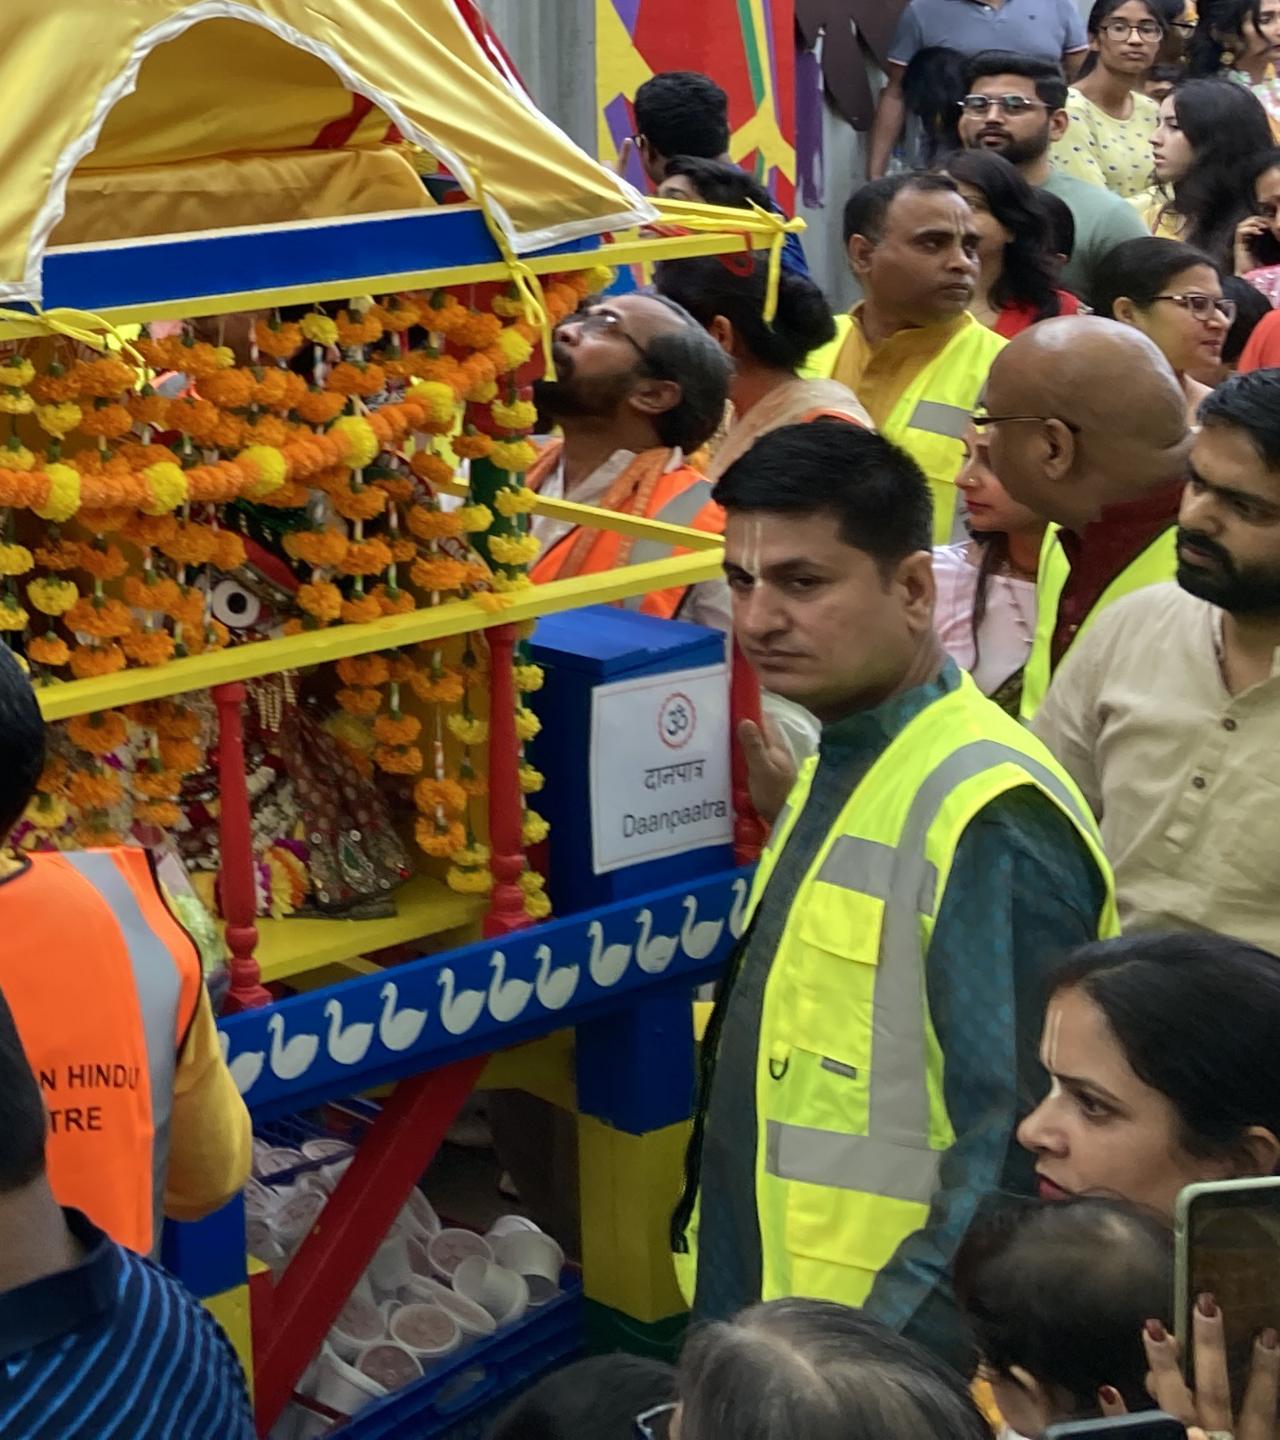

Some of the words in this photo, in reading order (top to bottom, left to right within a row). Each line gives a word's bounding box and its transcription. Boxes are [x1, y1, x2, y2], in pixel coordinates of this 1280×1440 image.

[644, 759, 707, 791] दानपात्र
[622, 800, 728, 838] Daanpaatra
[68, 1063, 140, 1090] HINDU
[49, 1106, 103, 1134] TRE
